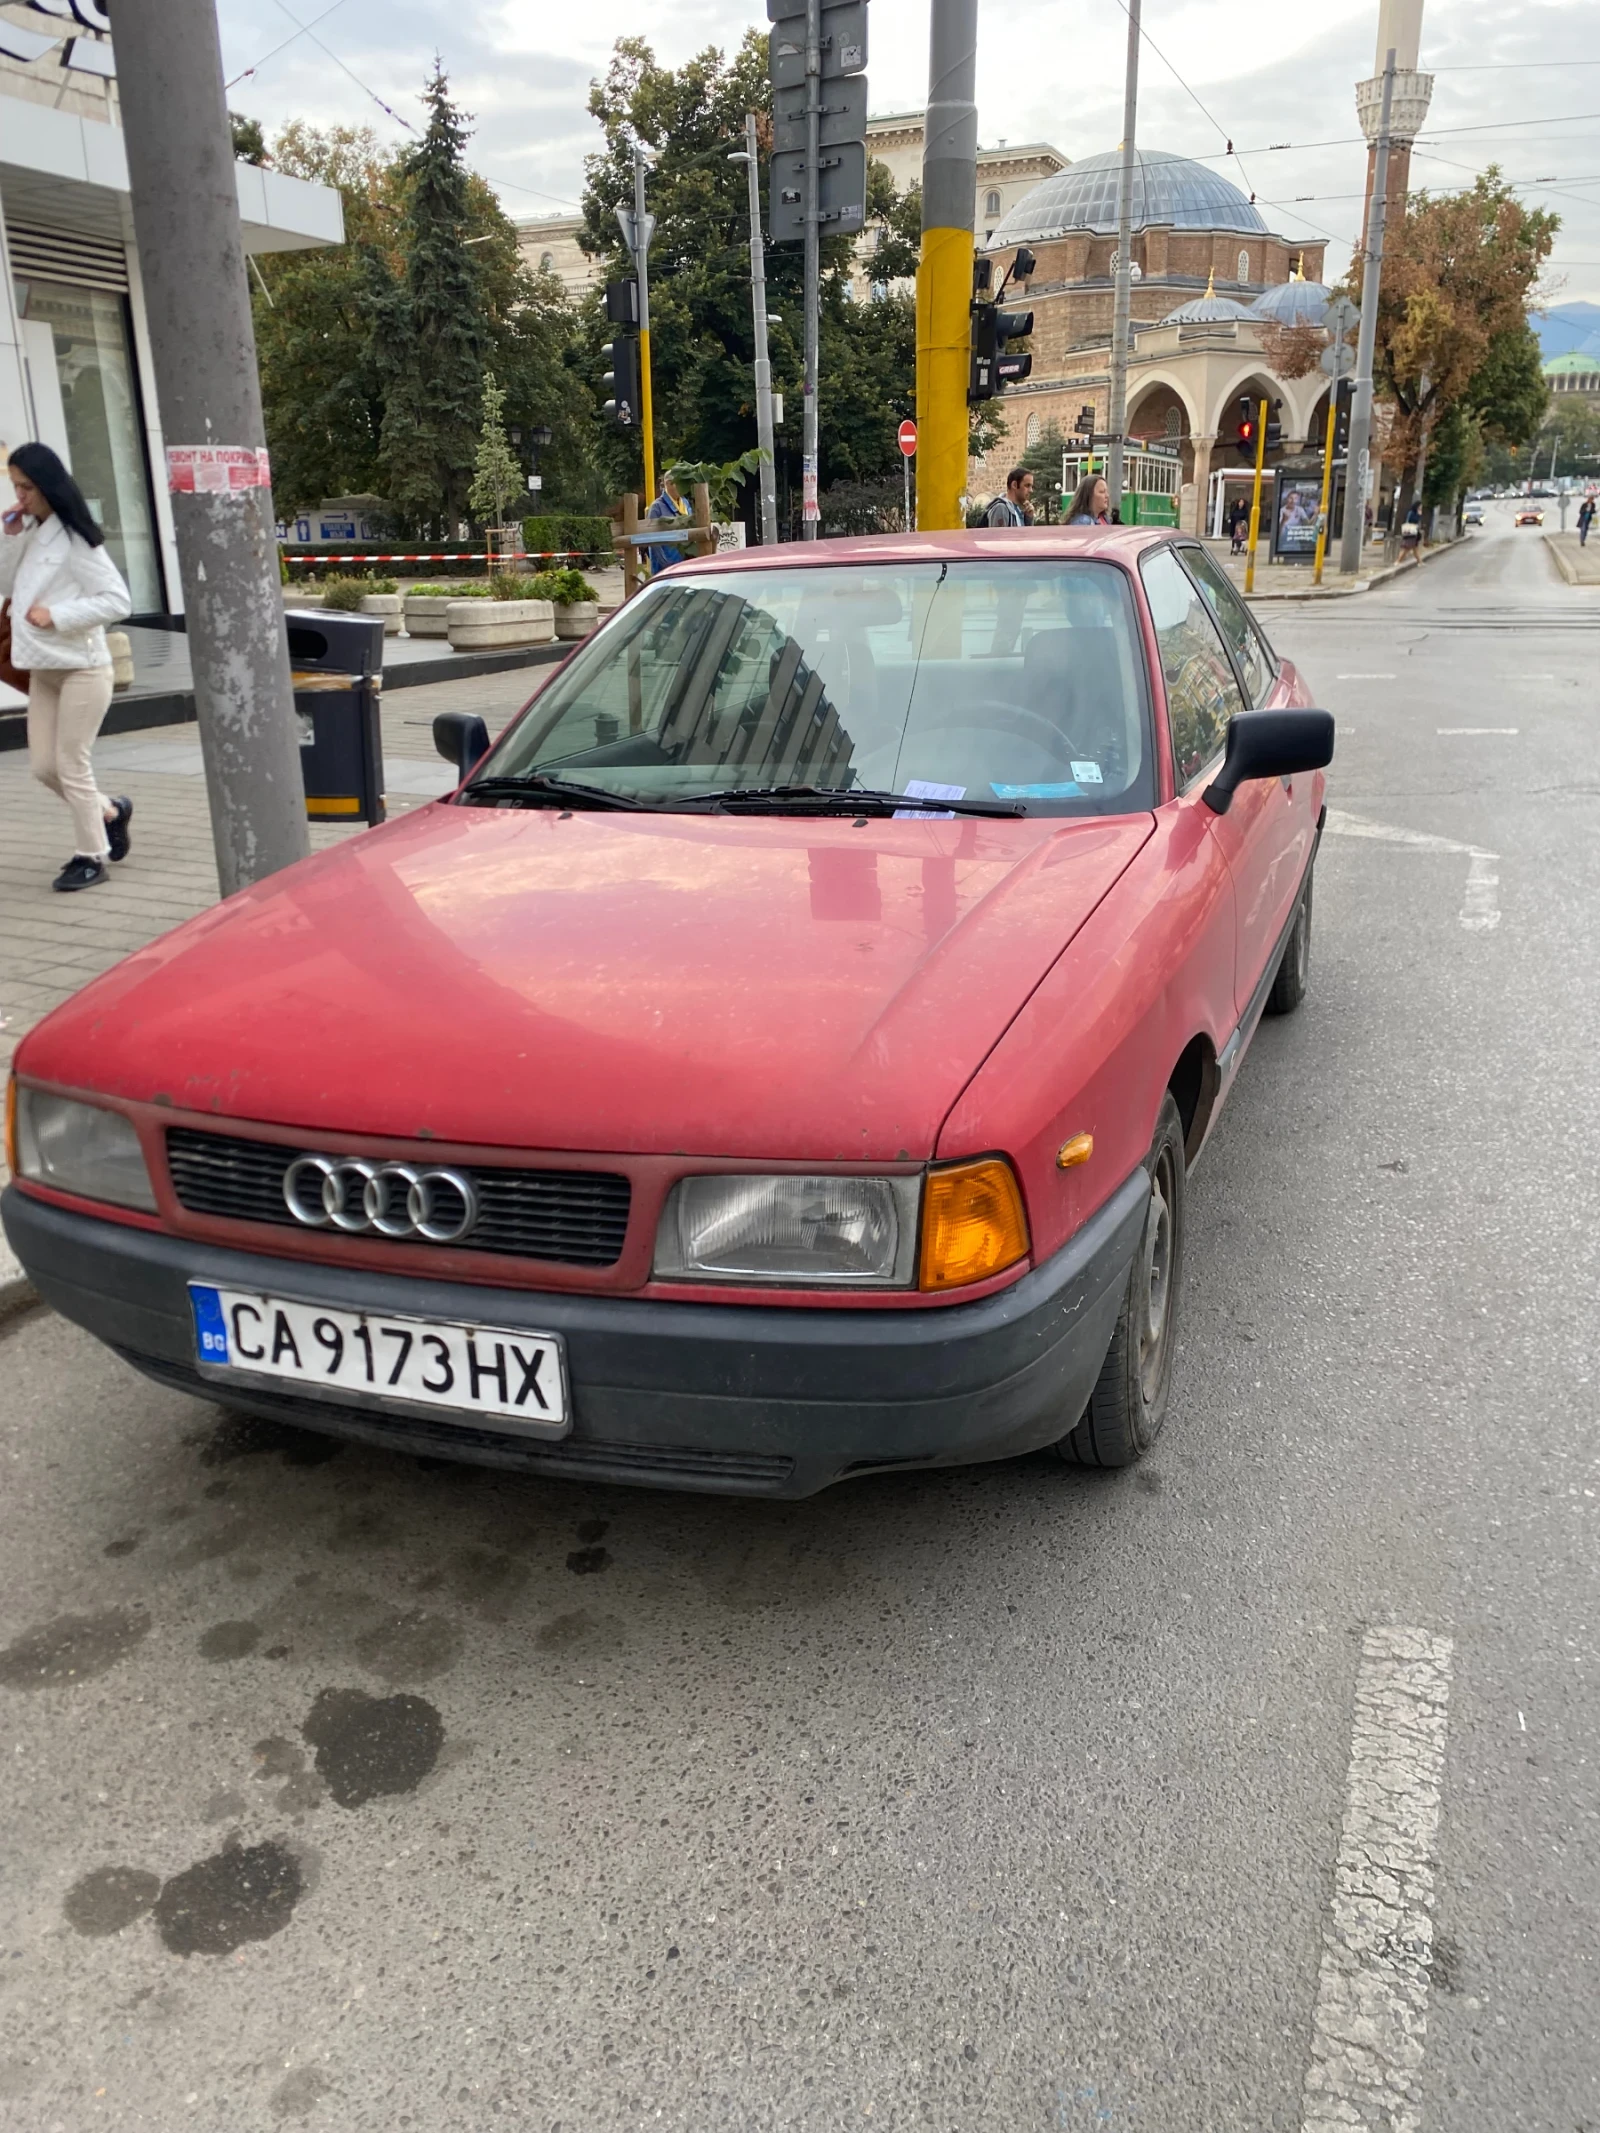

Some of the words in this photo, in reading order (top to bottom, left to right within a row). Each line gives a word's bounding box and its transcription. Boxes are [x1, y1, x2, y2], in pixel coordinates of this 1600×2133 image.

[200, 450, 214, 463] НА
[203, 1333, 226, 1352] BG
[231, 1303, 303, 1369] CA
[314, 1318, 455, 1394] 9173
[467, 1340, 551, 1410] HX
